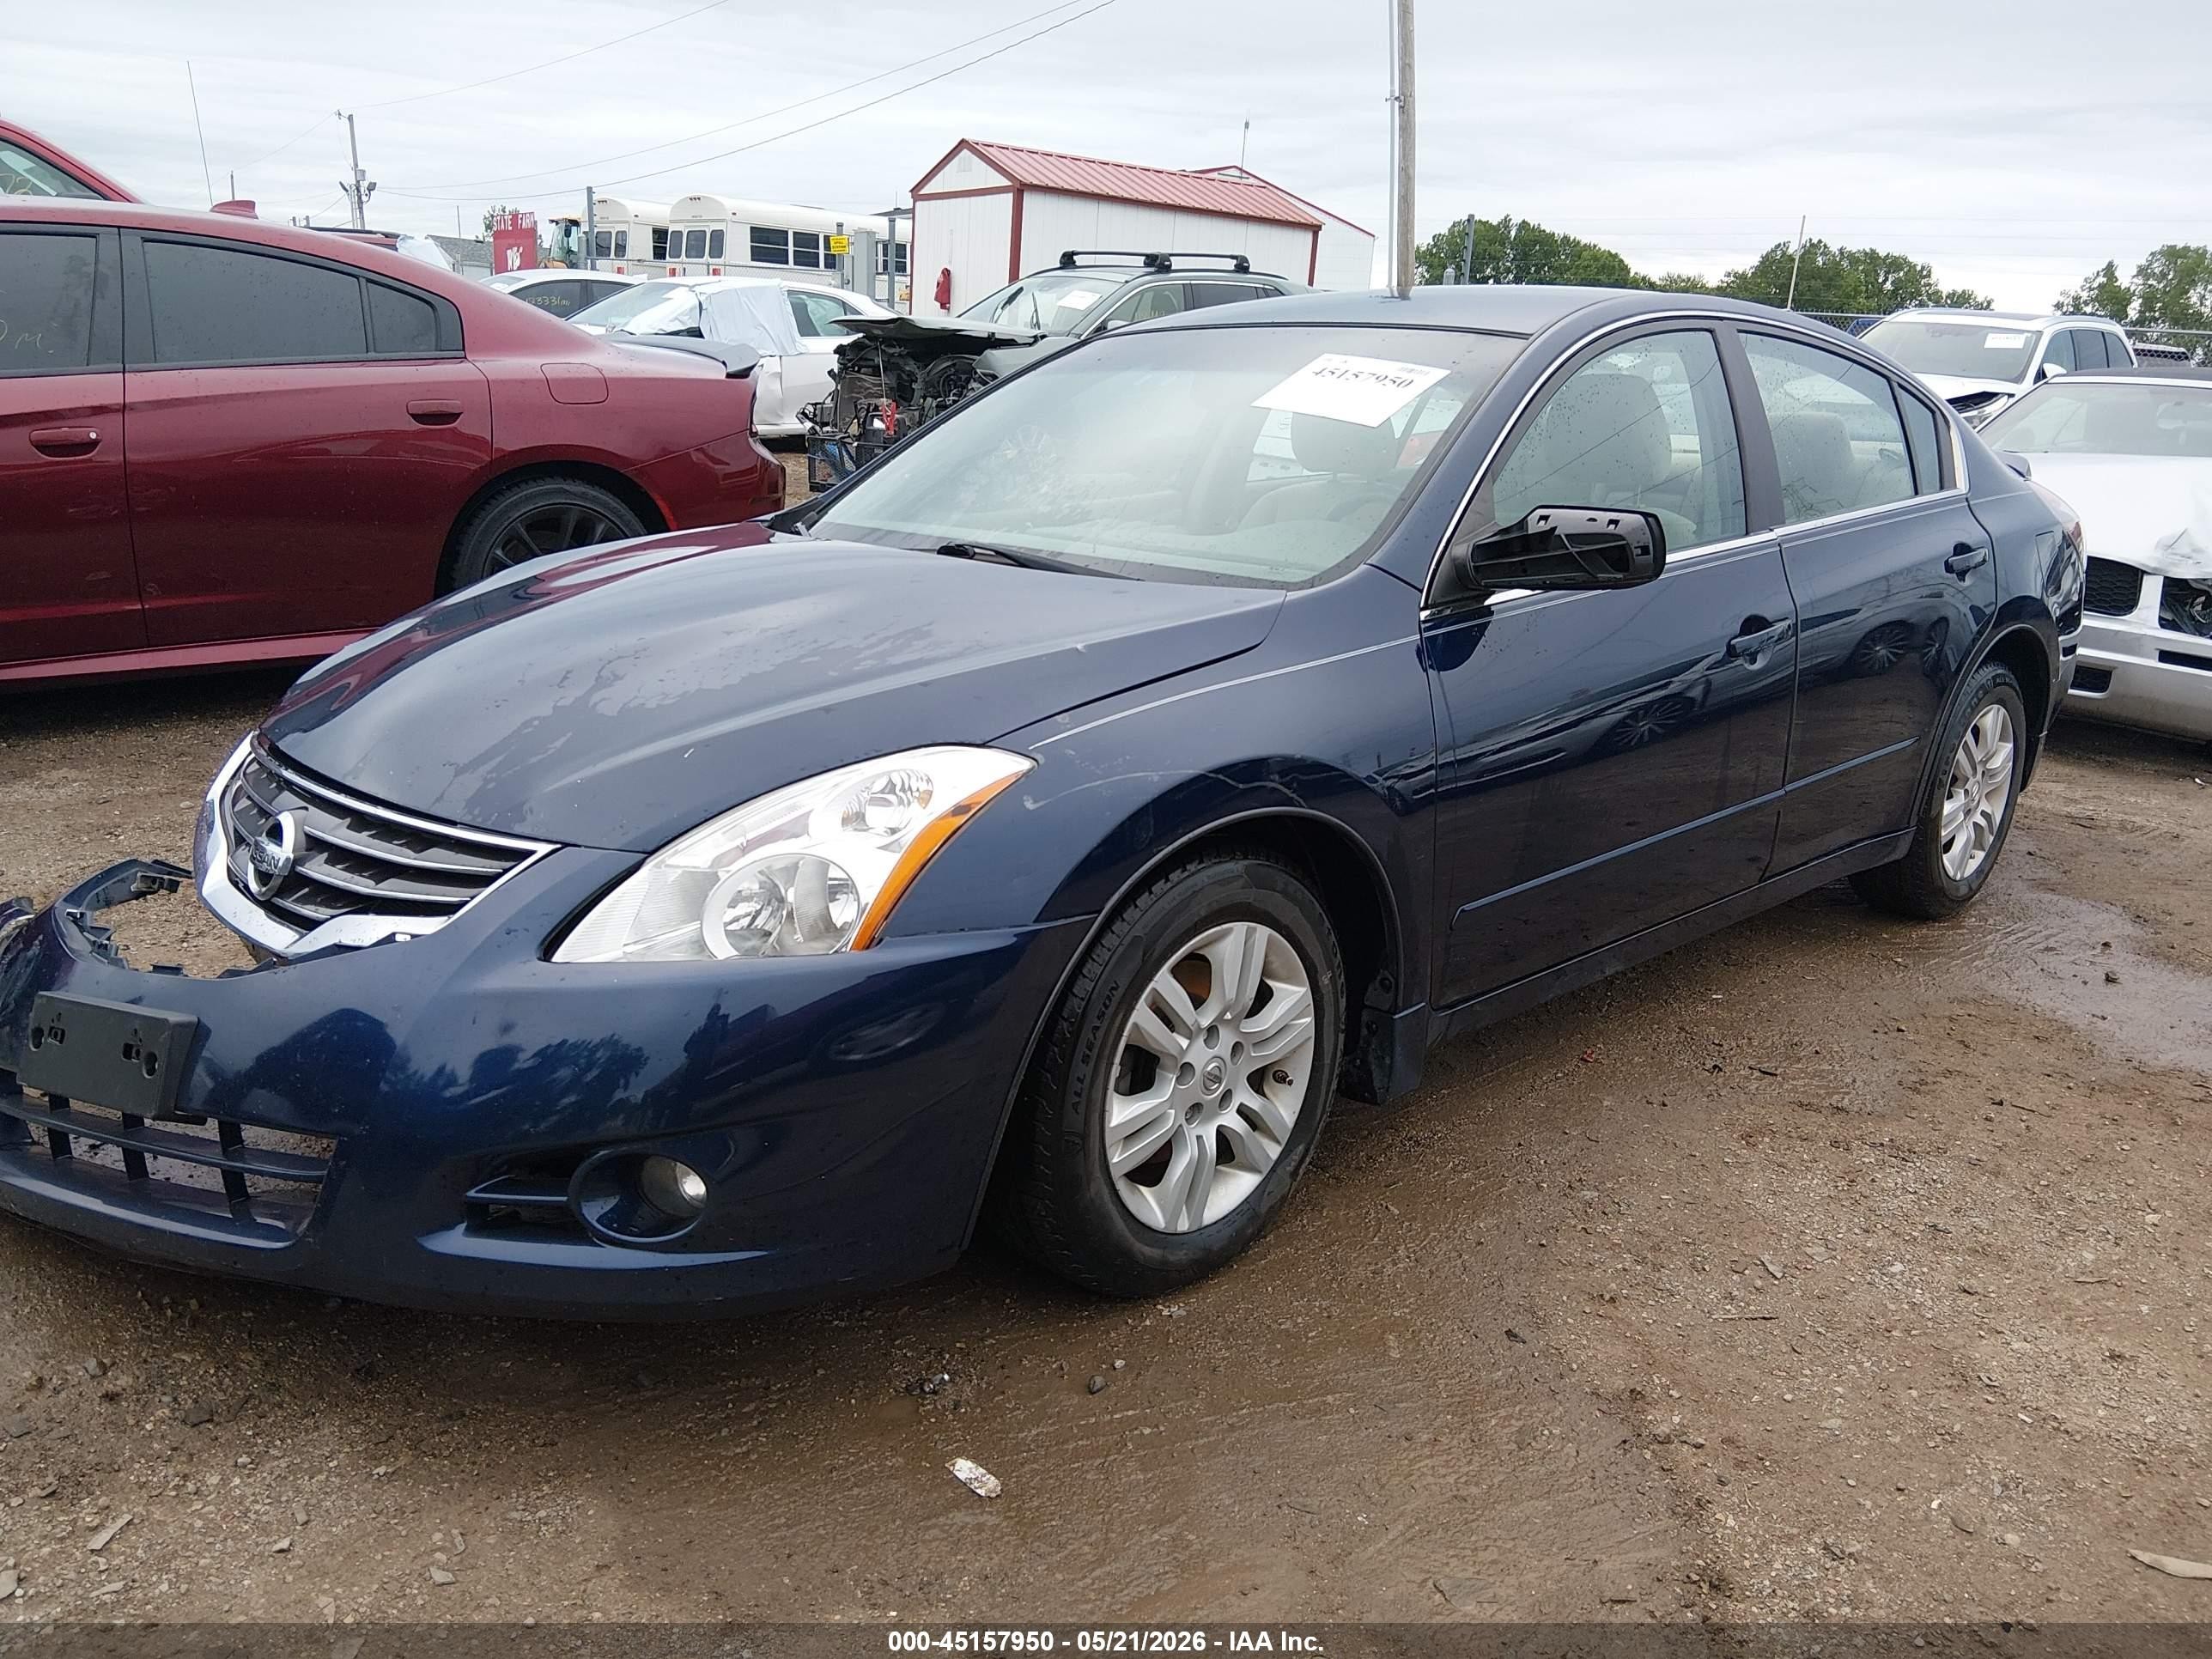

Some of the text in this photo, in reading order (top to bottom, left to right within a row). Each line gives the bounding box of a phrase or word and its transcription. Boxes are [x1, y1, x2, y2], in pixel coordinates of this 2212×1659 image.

[493, 212, 535, 231] STATE FARM
[1311, 367, 1414, 388] 45157950
[1071, 980, 1121, 1115] ALL SEASON
